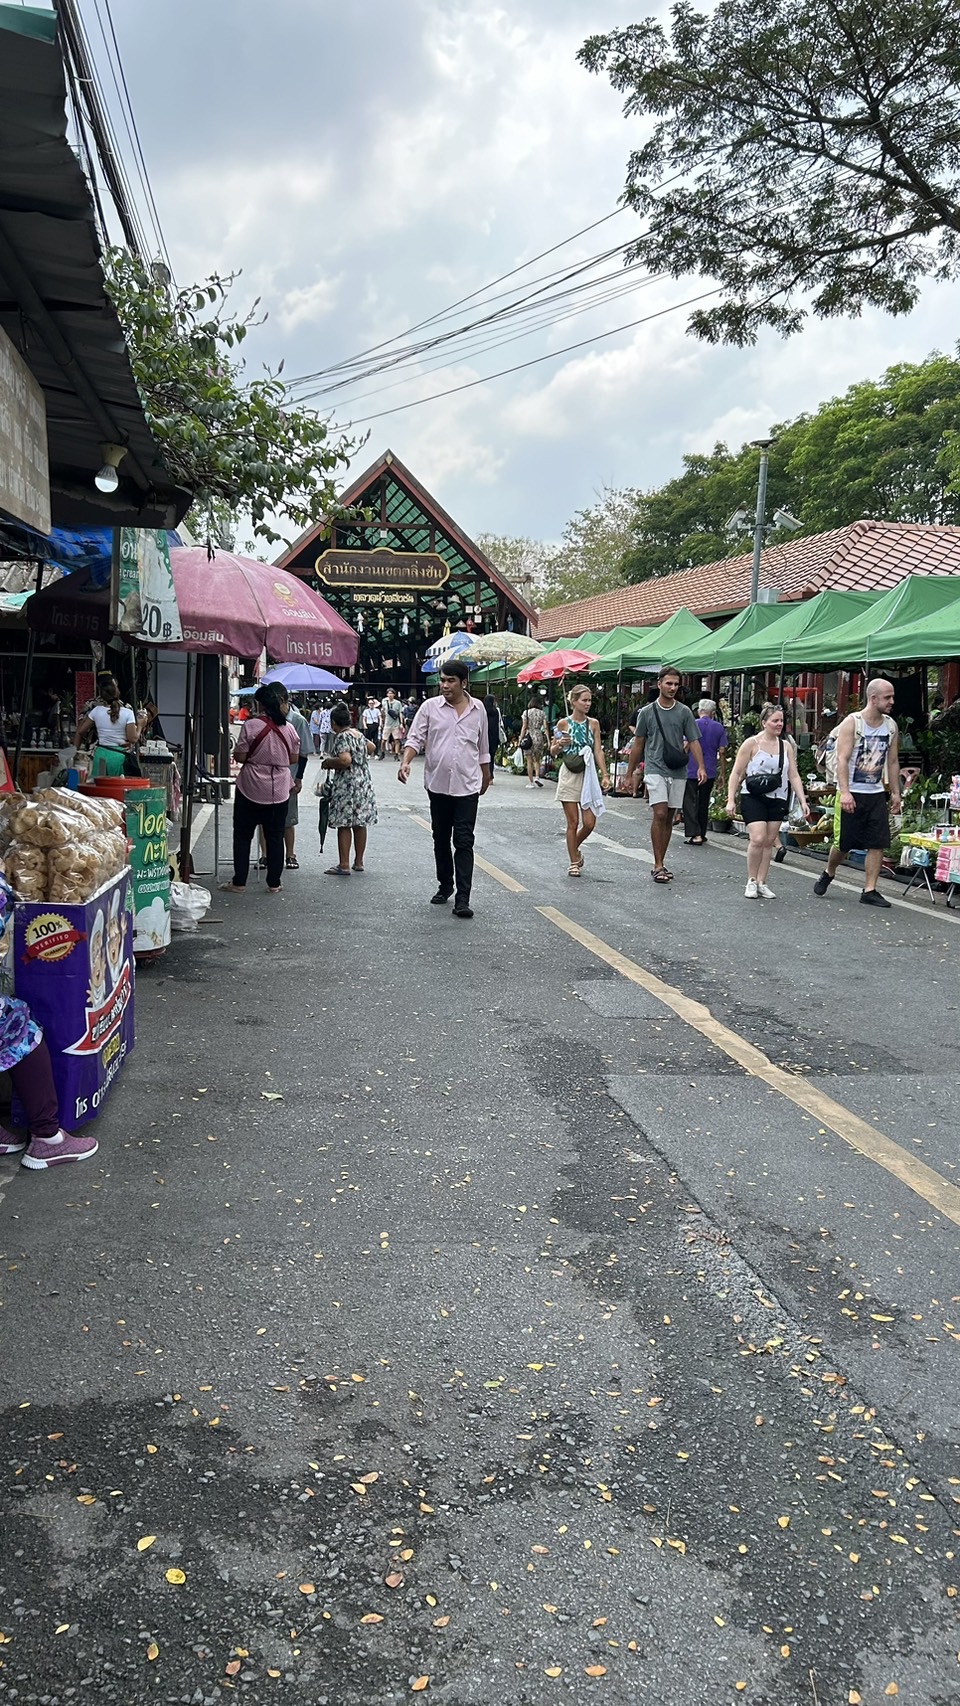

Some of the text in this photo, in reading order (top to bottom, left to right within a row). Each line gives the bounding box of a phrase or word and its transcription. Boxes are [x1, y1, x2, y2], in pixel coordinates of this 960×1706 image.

[323, 561, 442, 578] สำนักงานเขตตลิ่งชัน
[32, 921, 63, 939] 100%
